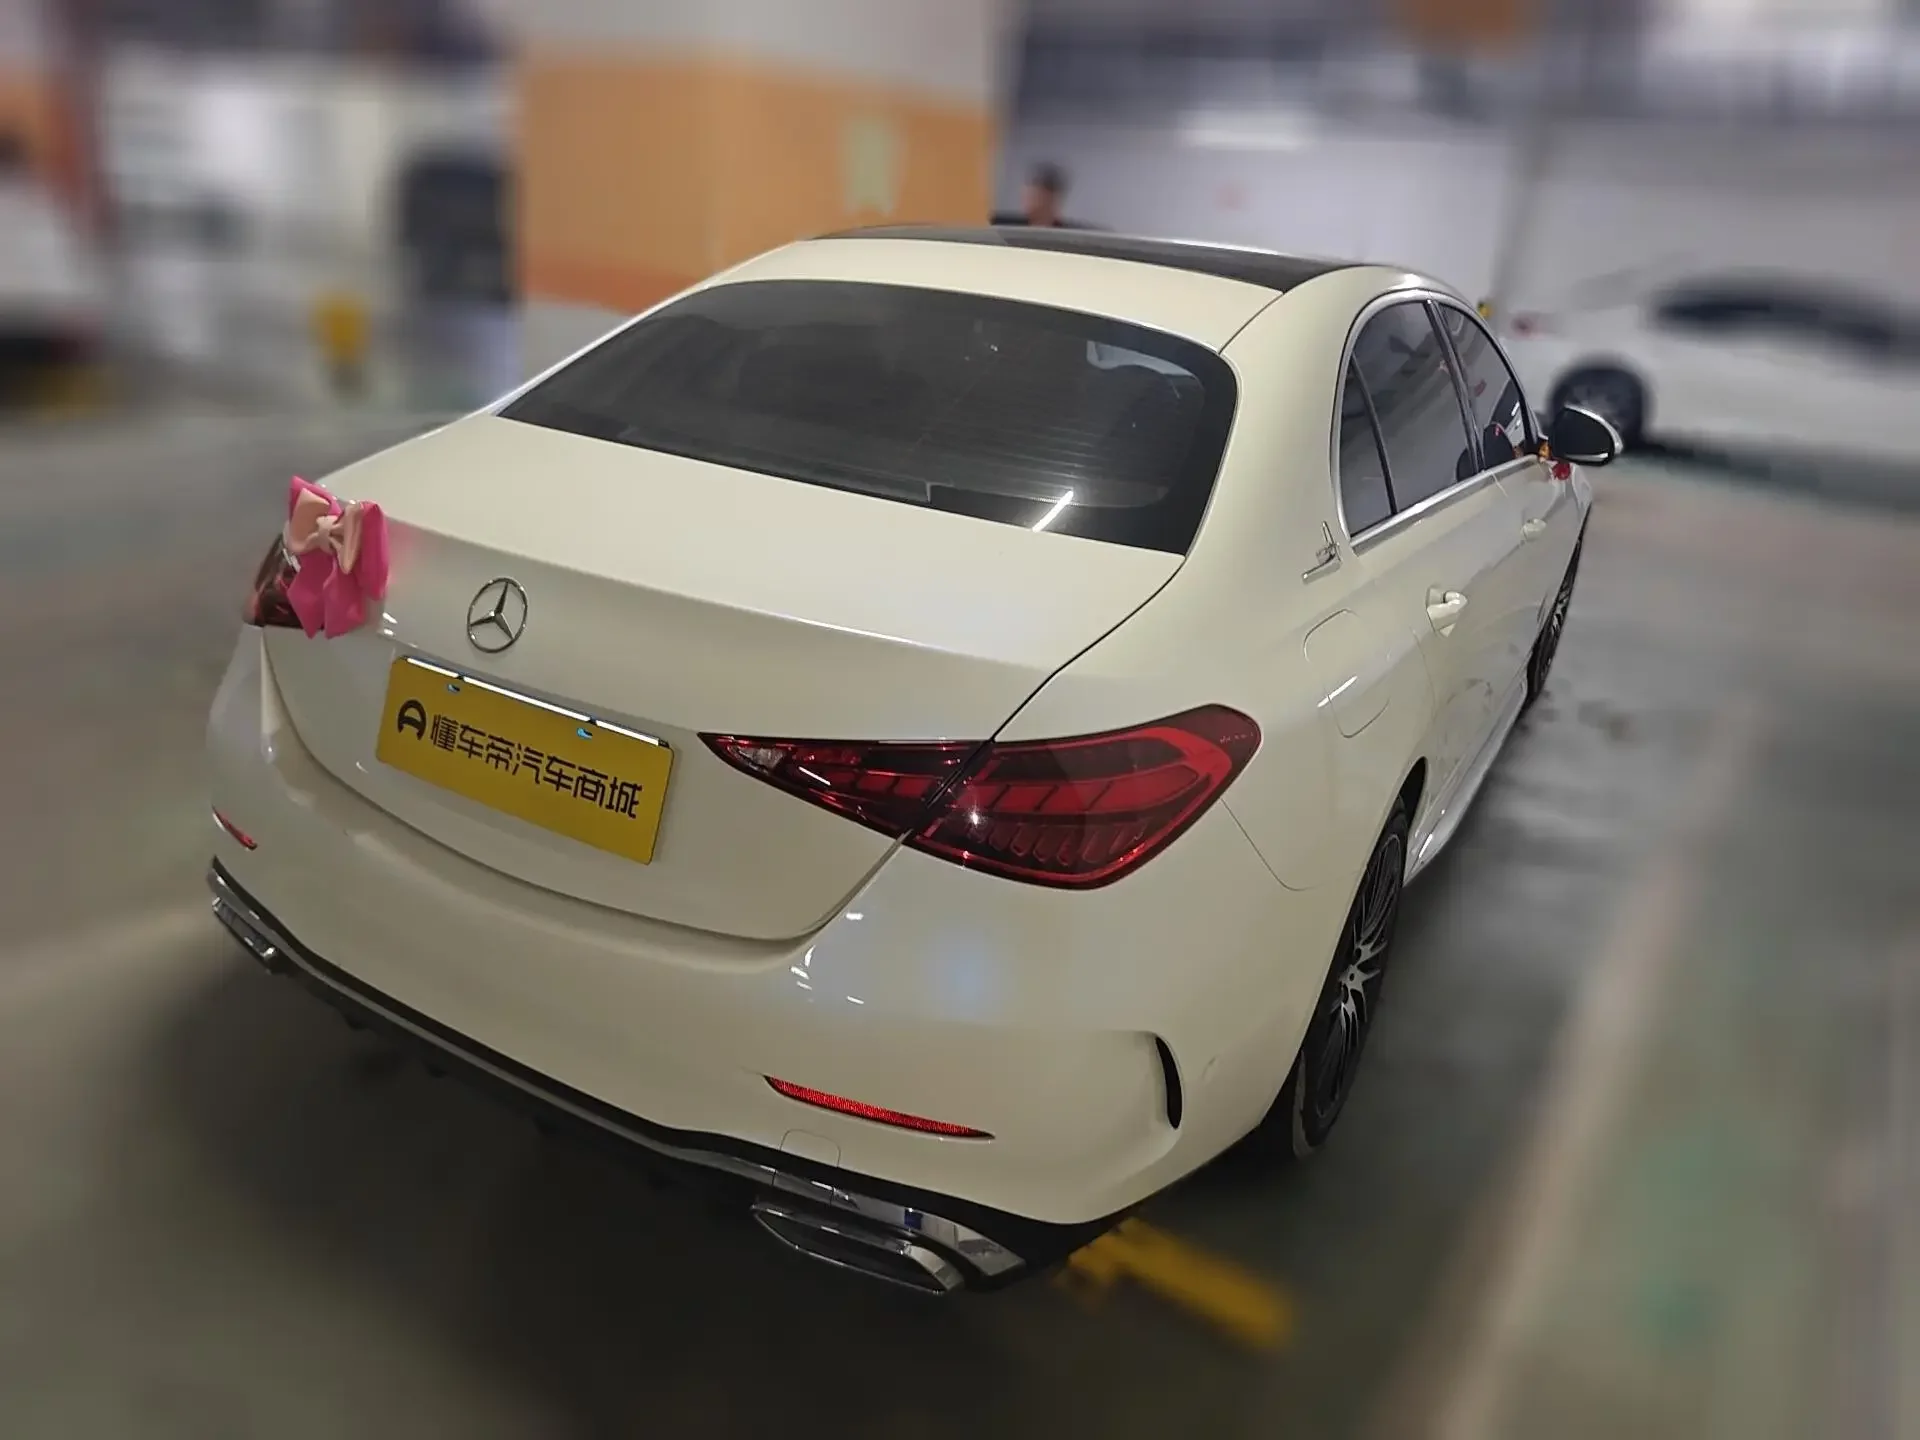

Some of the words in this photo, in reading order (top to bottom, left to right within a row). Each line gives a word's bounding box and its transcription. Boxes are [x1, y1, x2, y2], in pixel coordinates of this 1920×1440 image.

[430, 714, 643, 819] 懂车帝汽车商城
